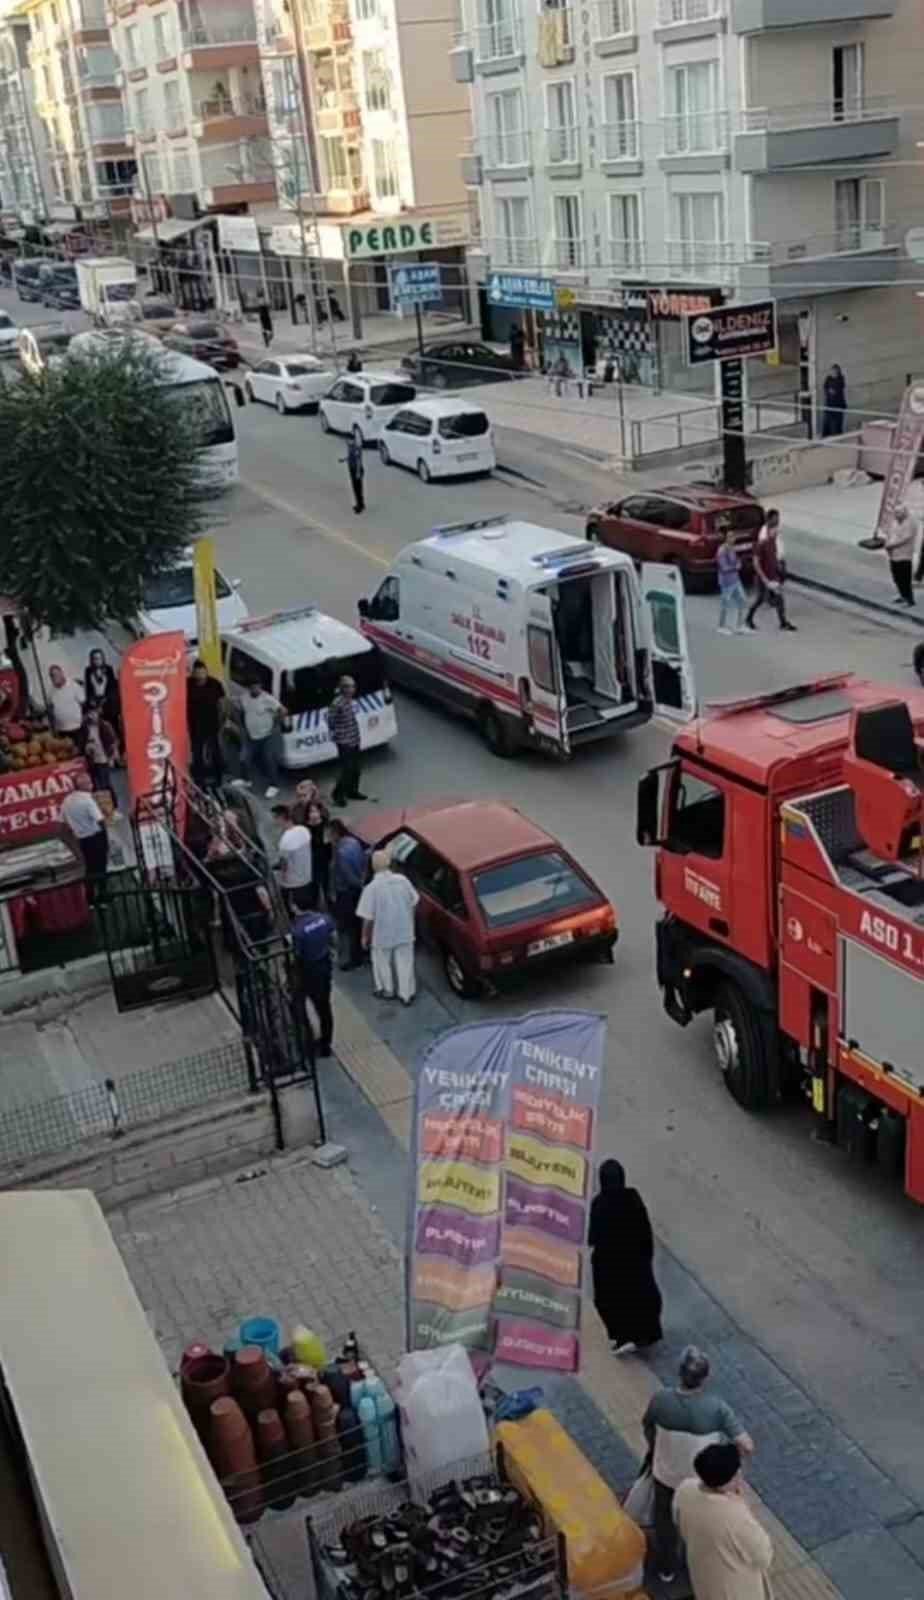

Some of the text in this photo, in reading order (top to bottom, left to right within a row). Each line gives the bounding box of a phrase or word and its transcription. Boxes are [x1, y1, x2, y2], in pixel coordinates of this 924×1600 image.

[350, 222, 433, 252] PERDE
[467, 634, 491, 660] 112
[0, 771, 77, 807] AMAN
